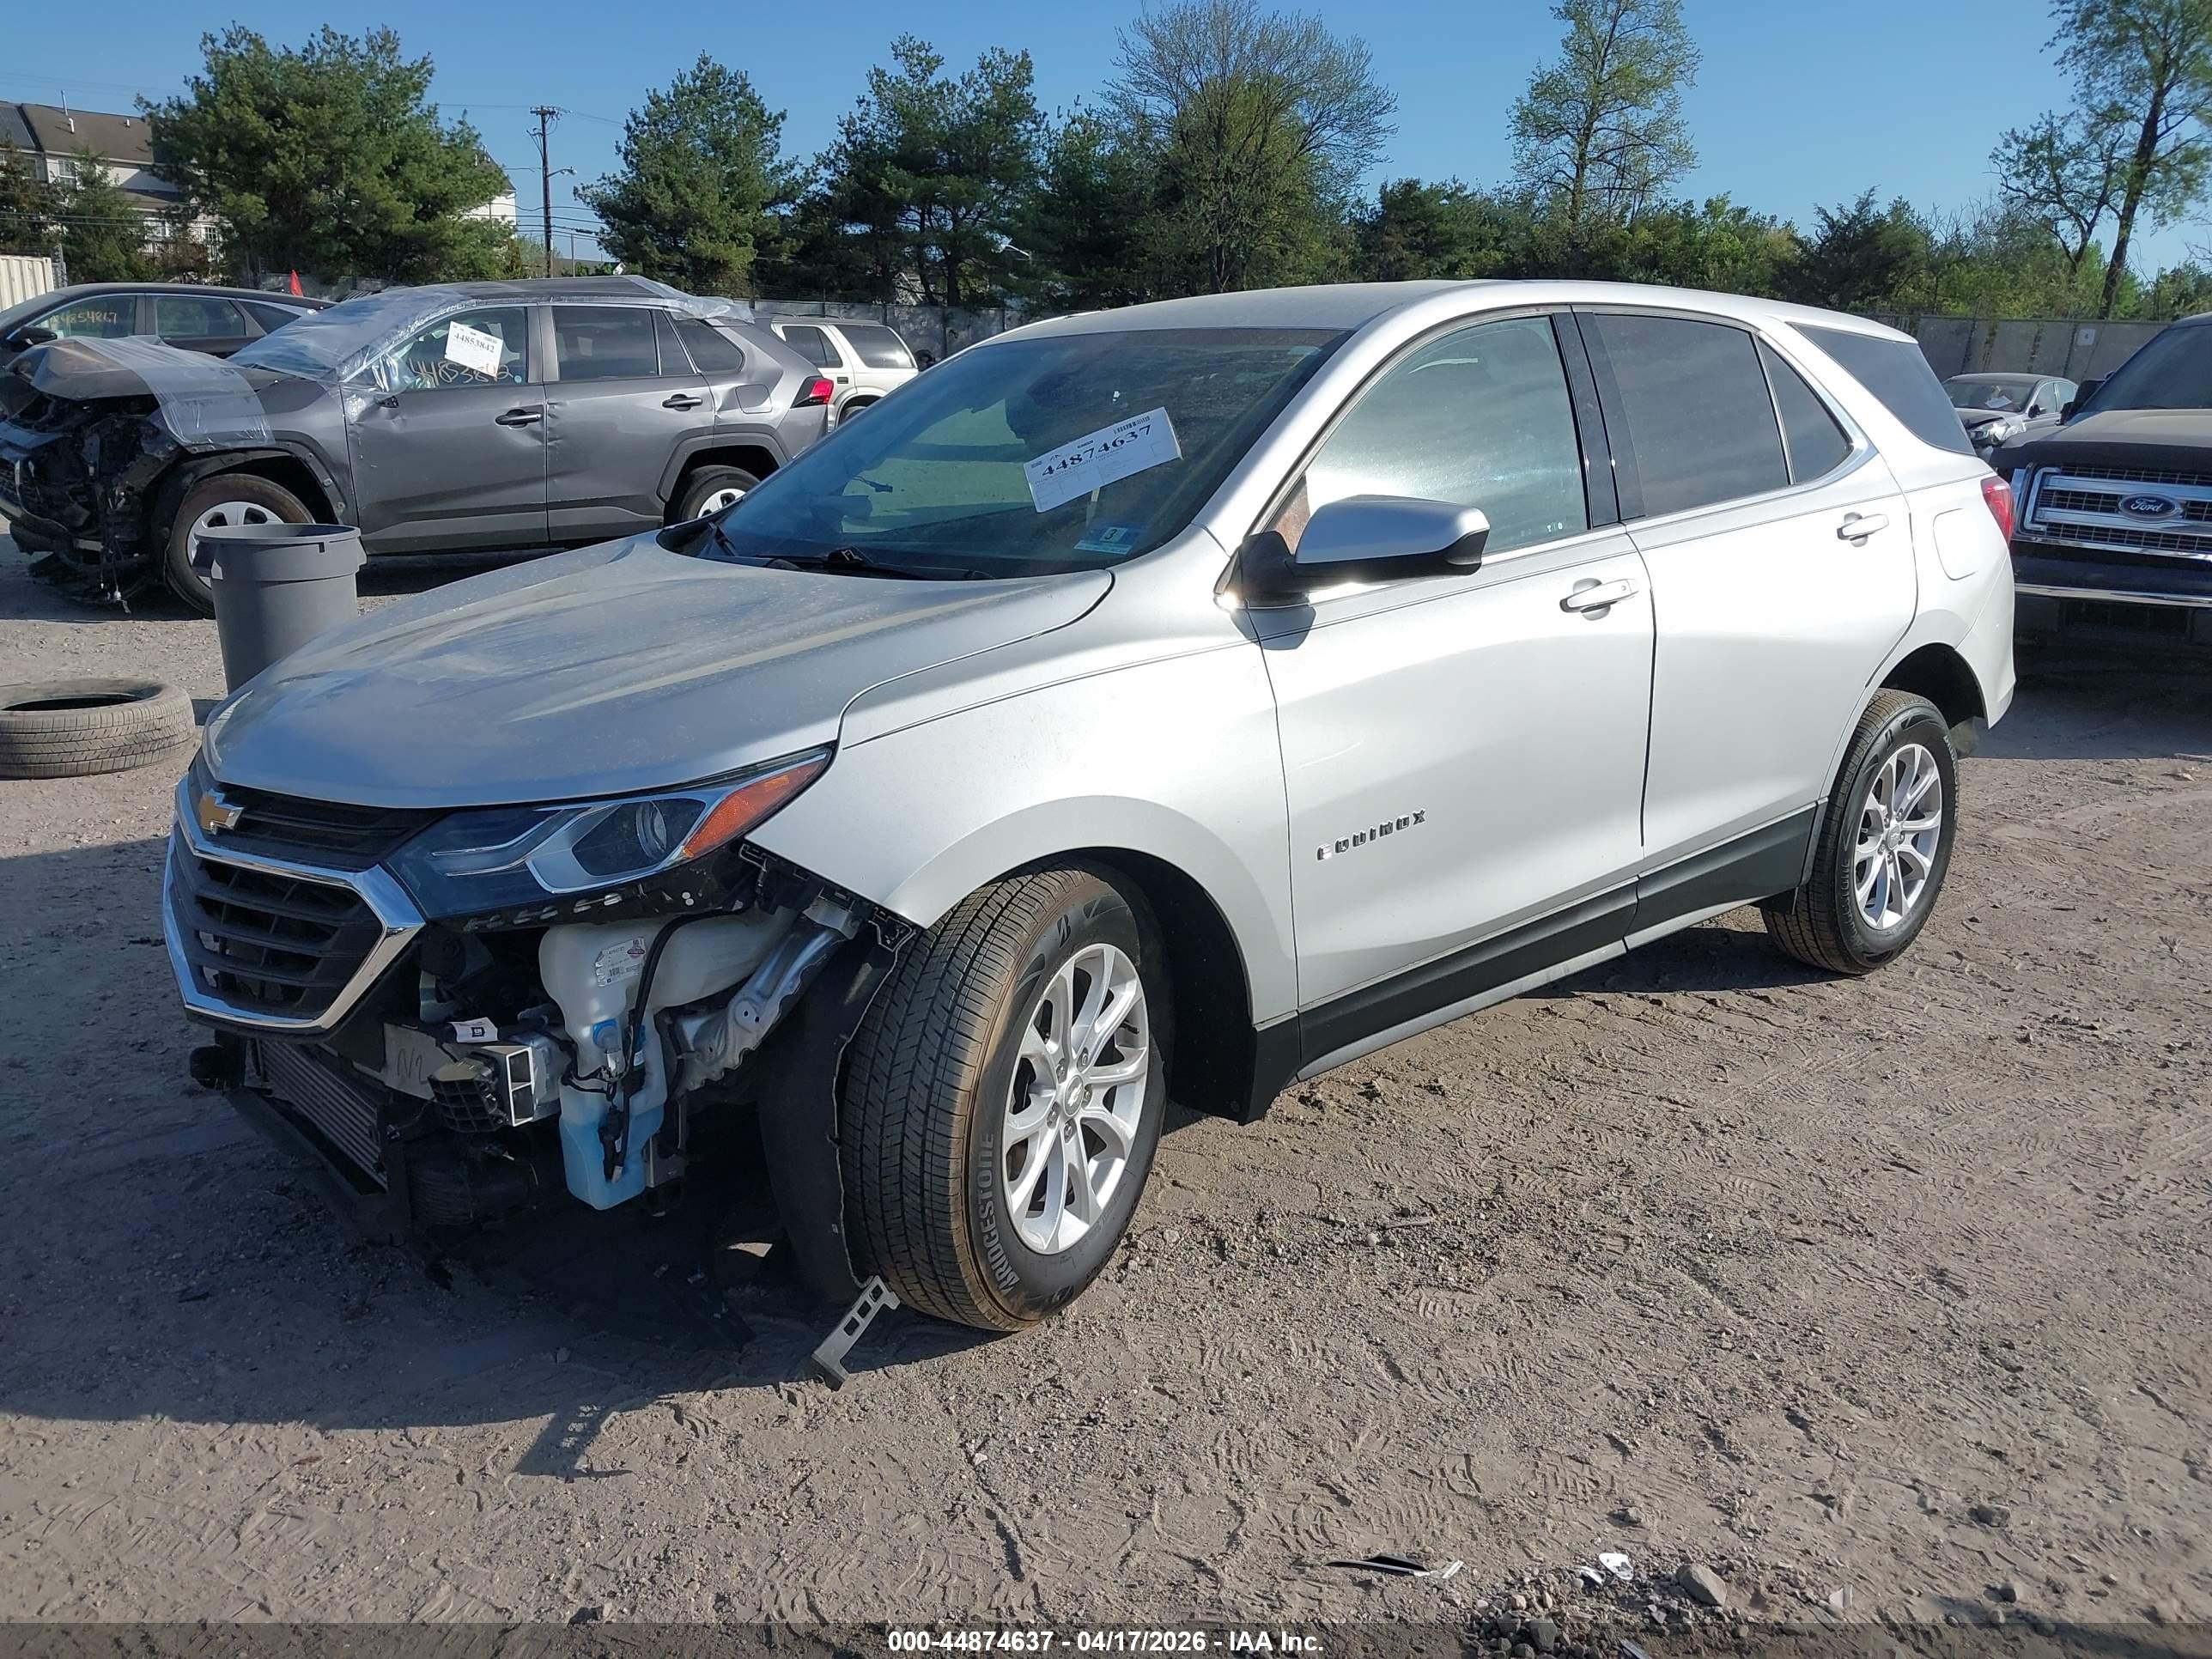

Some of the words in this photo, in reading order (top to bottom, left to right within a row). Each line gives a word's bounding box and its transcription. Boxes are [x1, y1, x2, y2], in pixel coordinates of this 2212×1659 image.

[453, 331, 495, 354] 44853842
[1042, 424, 1152, 478] 44874637
[2130, 498, 2164, 513] Ford
[1104, 528, 1118, 540] 3
[1316, 808, 1425, 861] EQUINOX
[977, 1133, 1021, 1297] BRIDGESTONE
